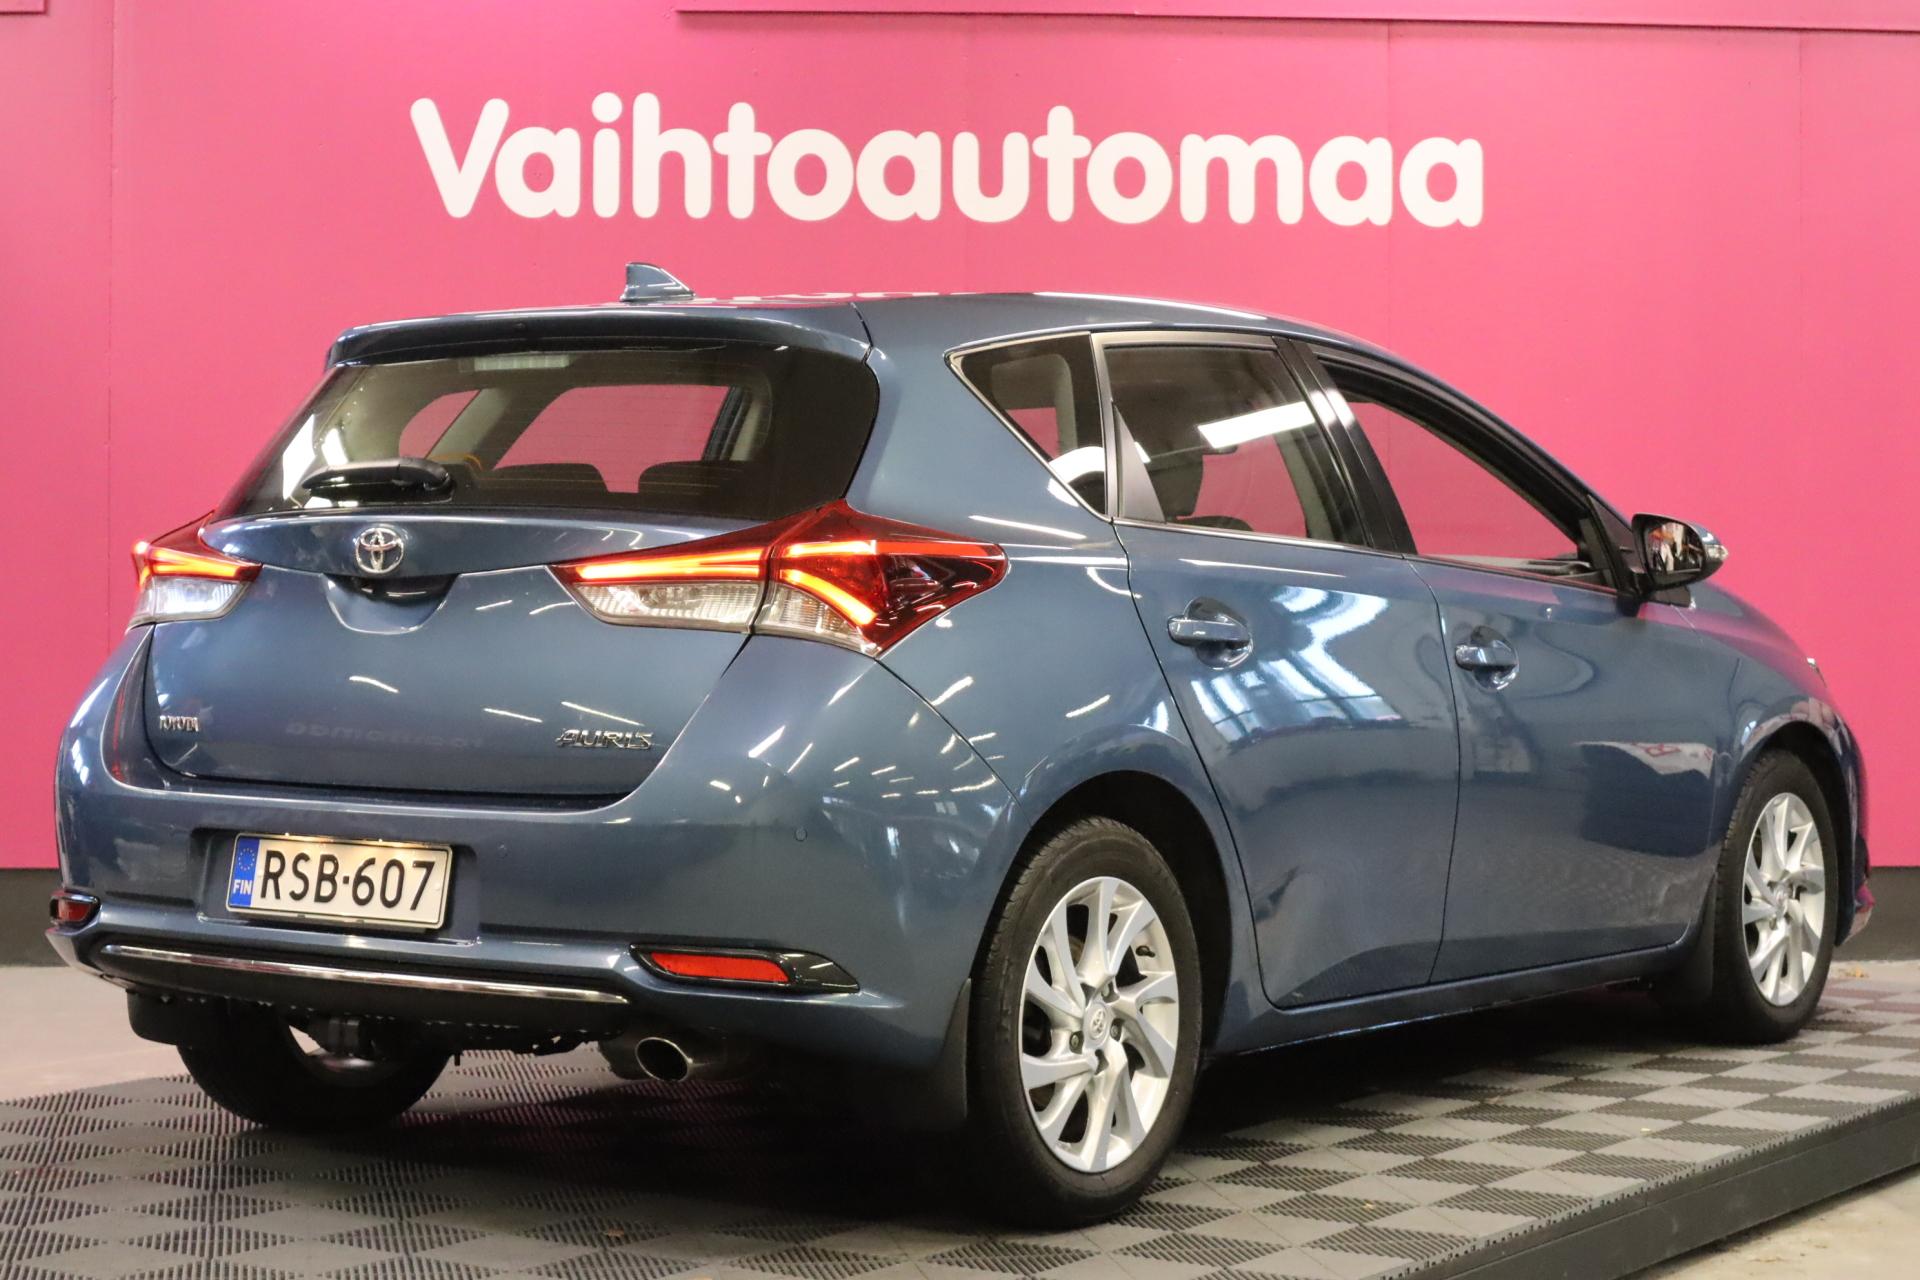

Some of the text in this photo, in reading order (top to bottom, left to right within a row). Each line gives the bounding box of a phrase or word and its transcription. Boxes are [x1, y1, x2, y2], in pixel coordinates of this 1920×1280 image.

[410, 93, 1484, 228] Vaihtoautomaa
[555, 729, 653, 749] AURIS
[232, 879, 253, 894] FIN
